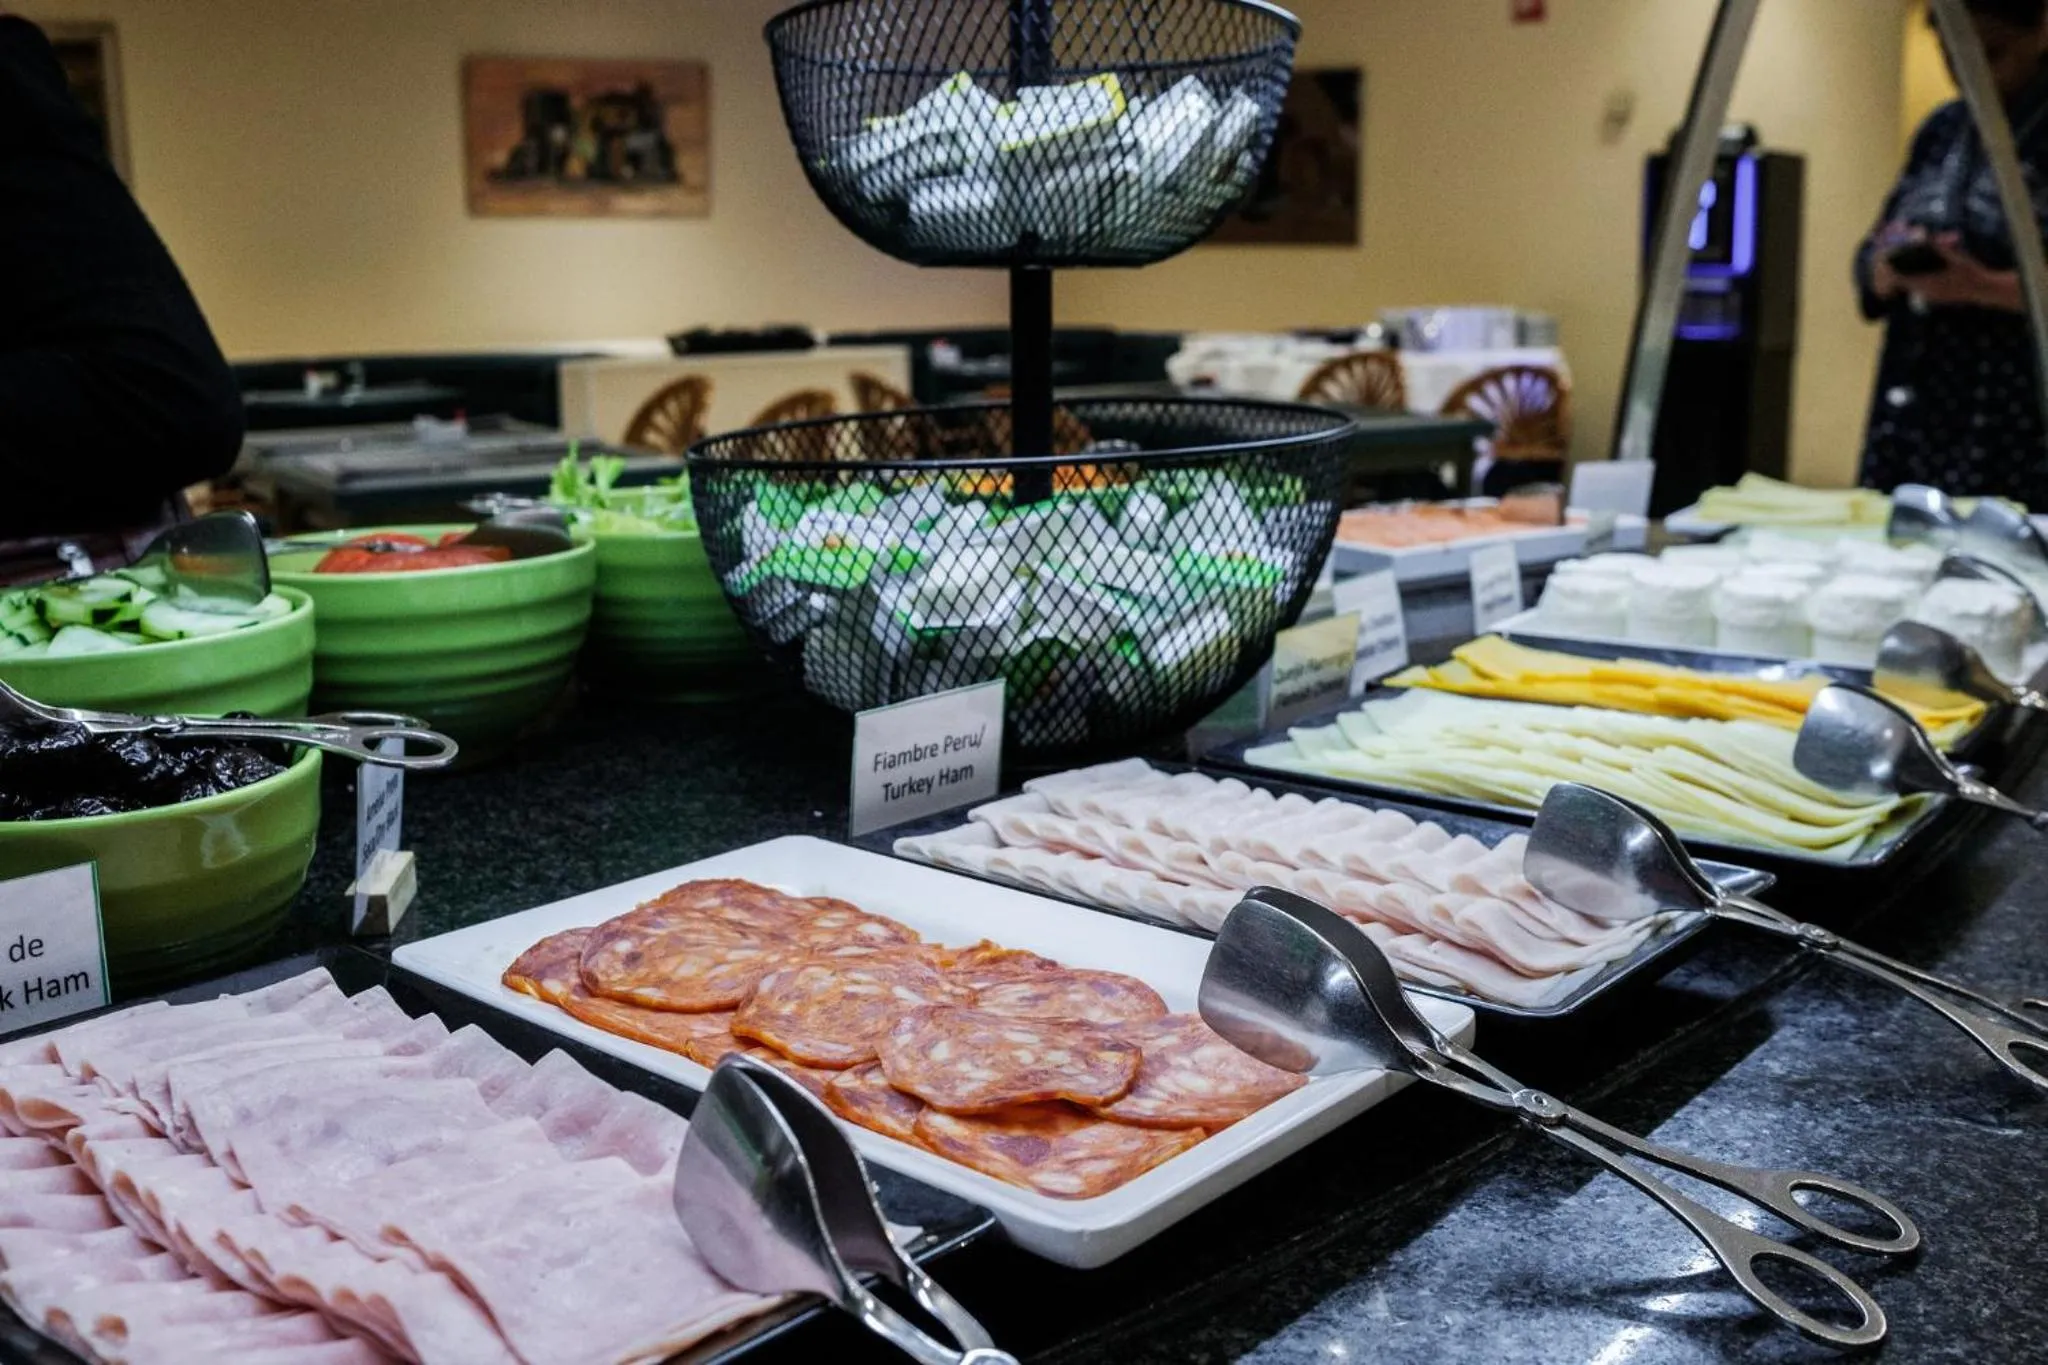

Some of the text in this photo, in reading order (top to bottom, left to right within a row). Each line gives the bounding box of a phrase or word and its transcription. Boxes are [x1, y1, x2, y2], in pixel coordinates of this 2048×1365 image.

[873, 722, 987, 774] Fiambre Peru/
[882, 763, 975, 803] Turkey Ham
[8, 934, 45, 964] de
[23, 970, 91, 1005] Ham
